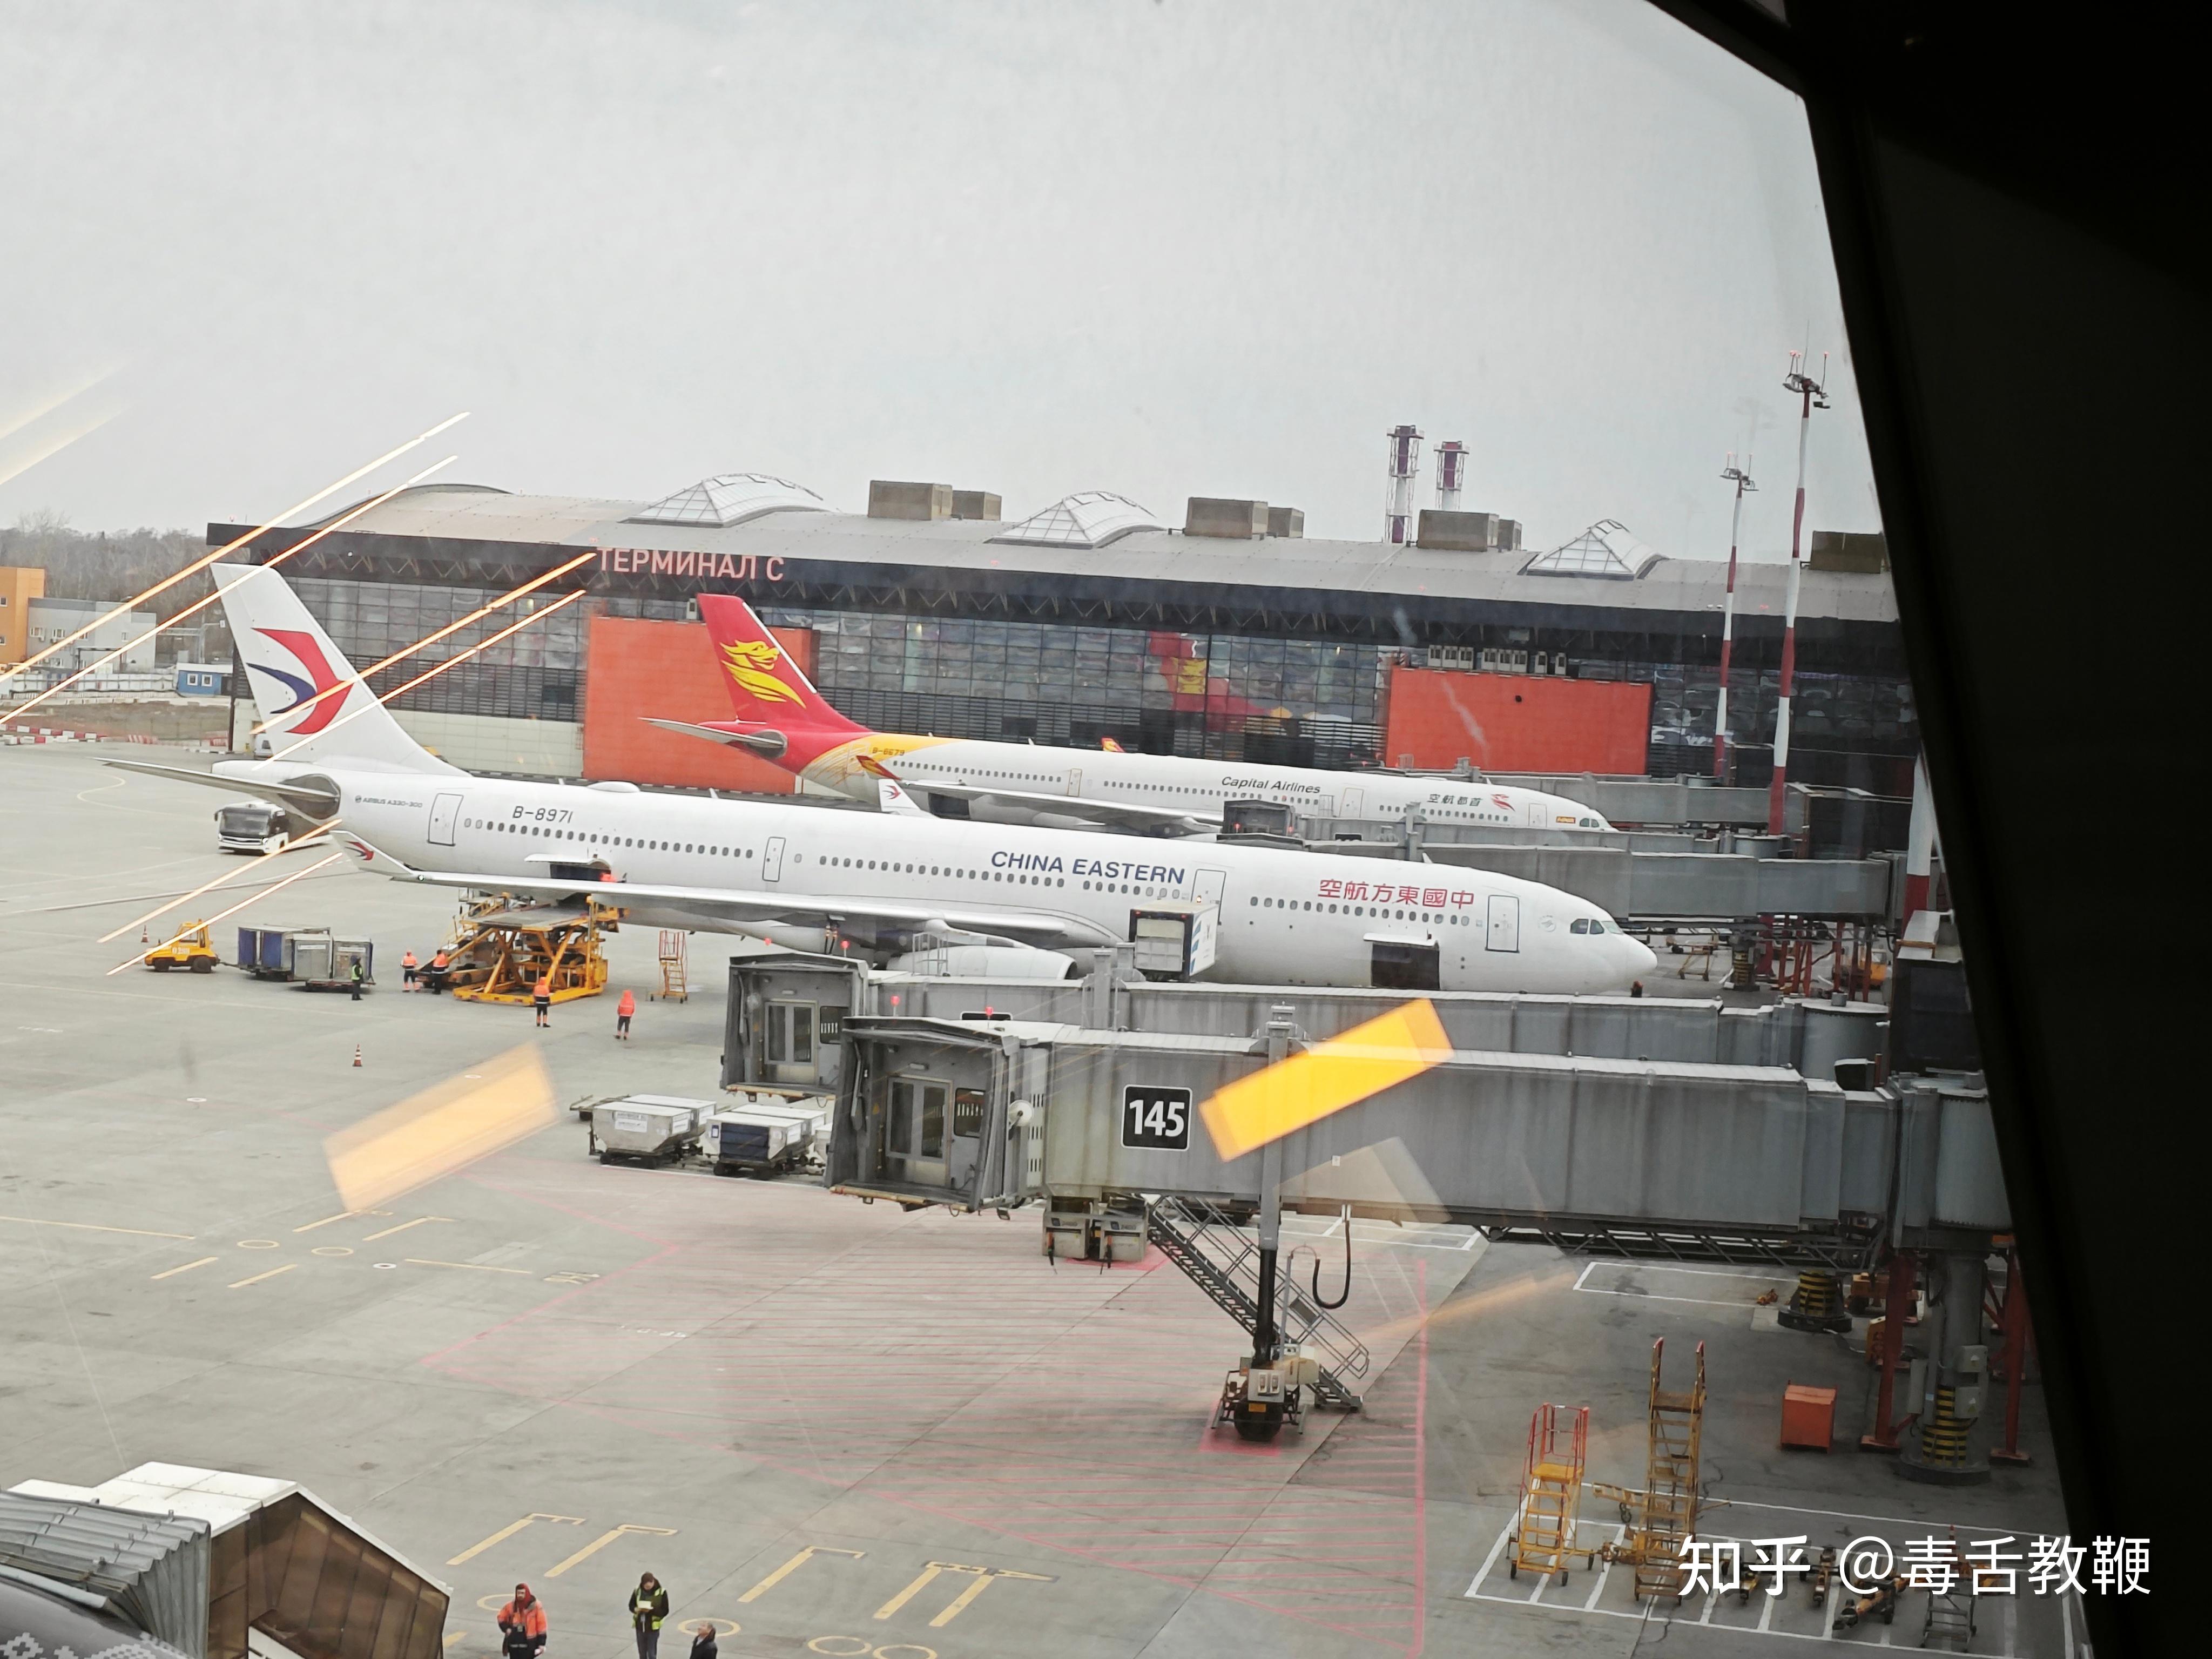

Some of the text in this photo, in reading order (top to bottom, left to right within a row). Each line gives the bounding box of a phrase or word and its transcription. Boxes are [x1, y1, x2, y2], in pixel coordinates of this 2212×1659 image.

[596, 547, 756, 579] ТЕРМИНАЛ
[1222, 777, 1320, 793] Capital Airlines
[512, 806, 573, 824] B-8971
[991, 851, 1185, 884] CHINA EASTERN
[1129, 1100, 1185, 1137] 145
